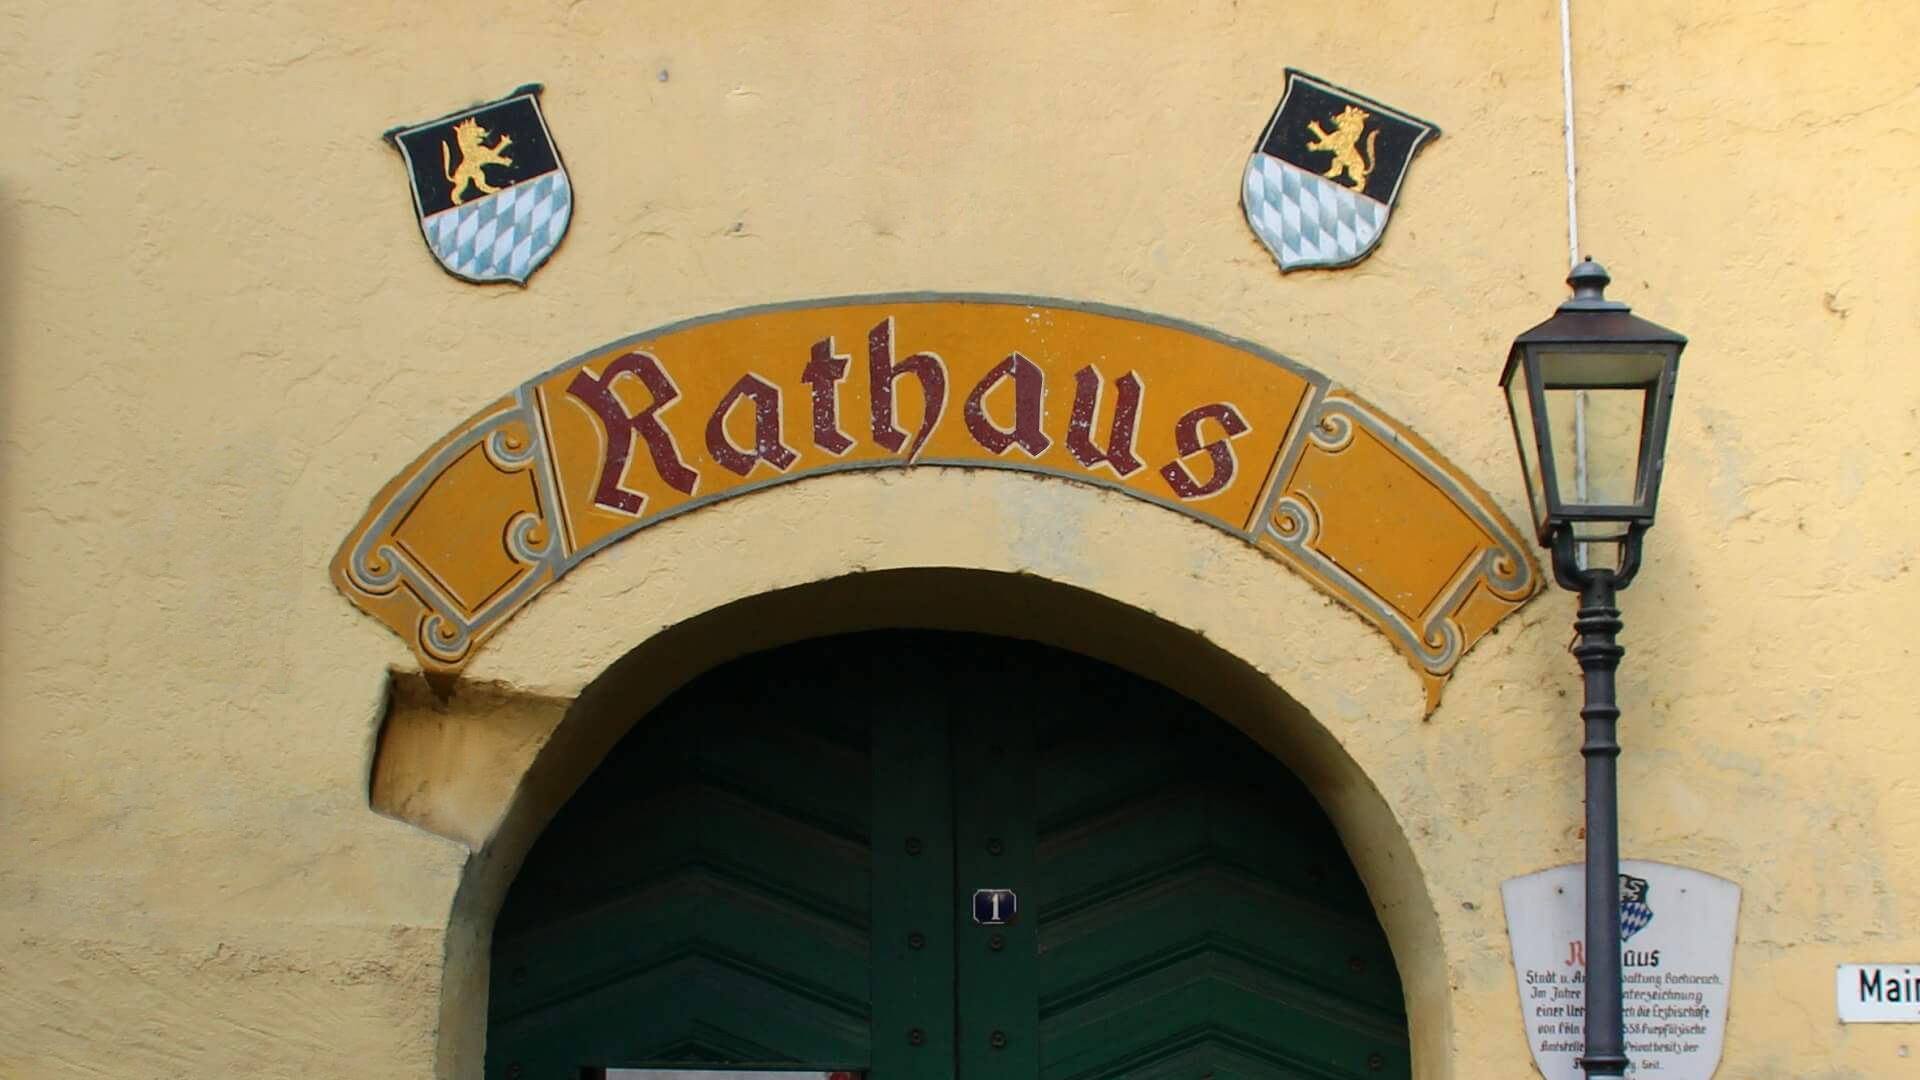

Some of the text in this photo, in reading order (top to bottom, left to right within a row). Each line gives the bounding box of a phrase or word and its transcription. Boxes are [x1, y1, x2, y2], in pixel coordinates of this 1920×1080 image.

[566, 315, 1252, 518] Rathaus
[991, 893, 1001, 920] 1
[1565, 939, 1660, 967] Raus
[1525, 970, 1556, 985] Stadt
[1550, 987, 1581, 1001] Jahre
[1536, 1005, 1564, 1017] einer
